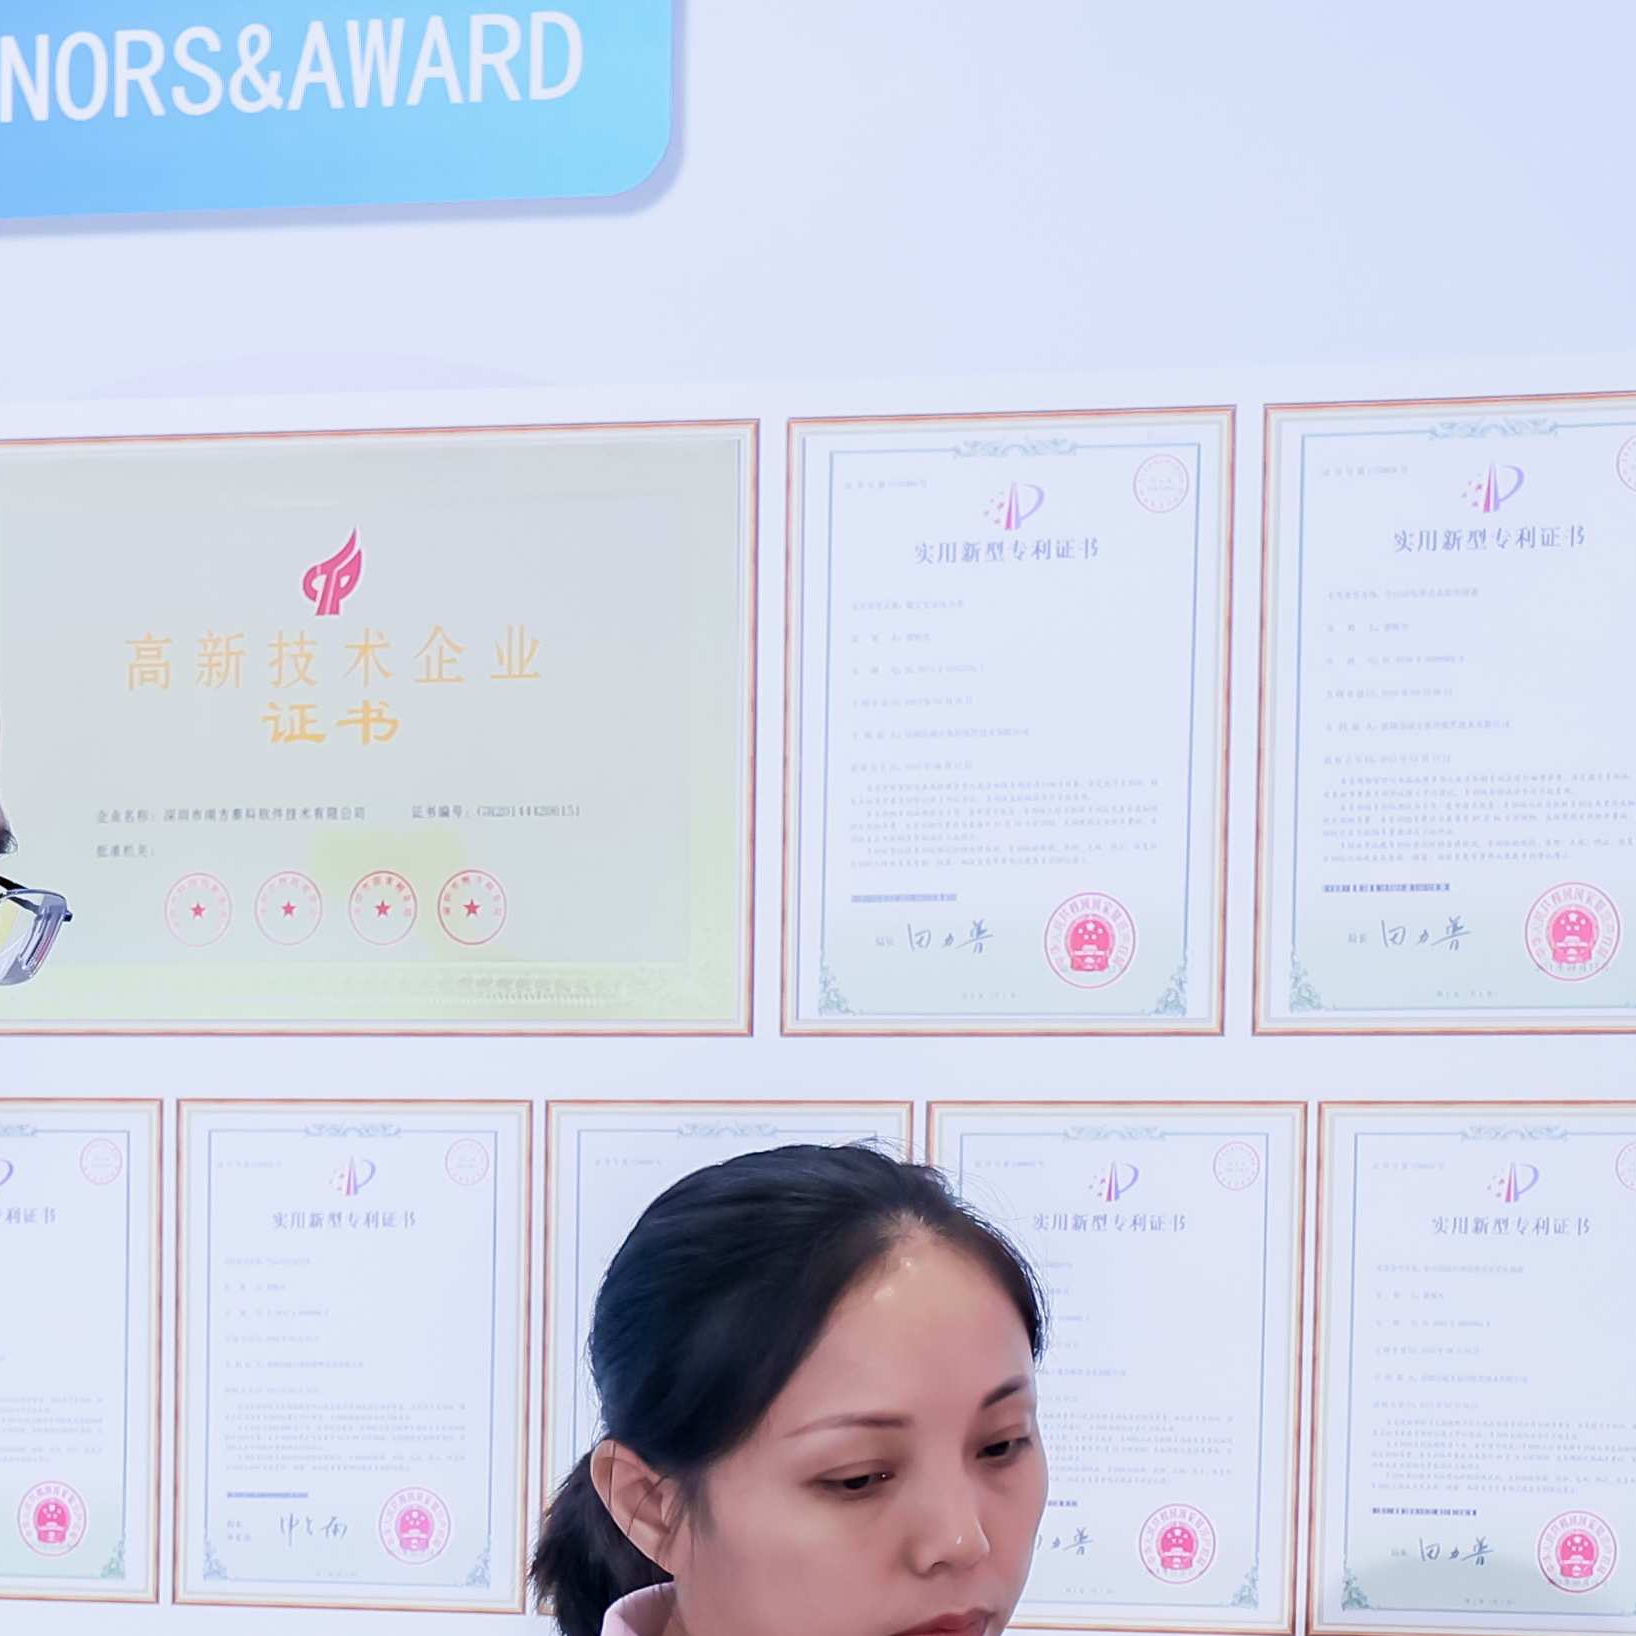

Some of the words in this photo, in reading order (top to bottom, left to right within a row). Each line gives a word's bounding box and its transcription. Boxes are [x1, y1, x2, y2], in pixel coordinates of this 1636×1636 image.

[914, 537, 1099, 565] 实用新型专利证书
[1393, 524, 1586, 553] 实用新型专利证书
[124, 624, 542, 691] 高新技术企业
[261, 699, 401, 746] 证书
[272, 1210, 417, 1231] 实用新型专利证书
[1033, 1211, 1186, 1234] 实用新型专利证书
[1432, 1215, 1591, 1237] 实用新型专利证书
